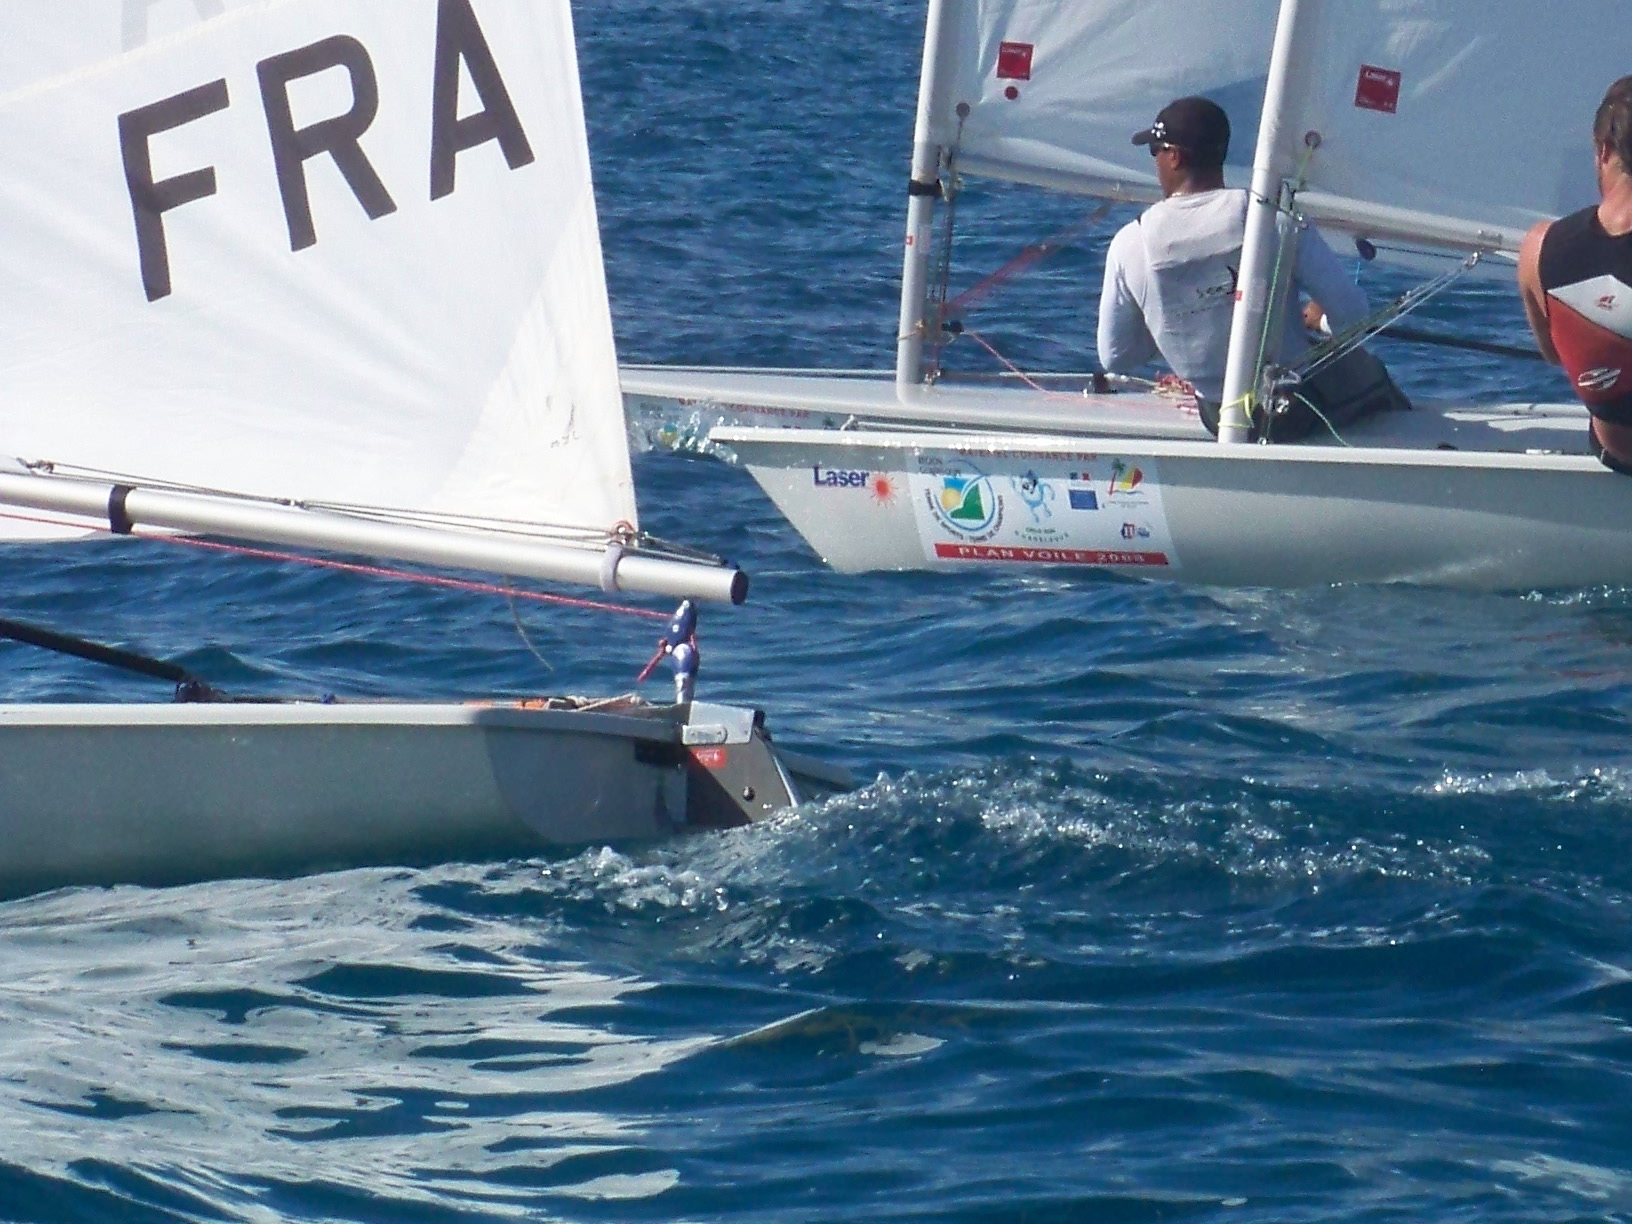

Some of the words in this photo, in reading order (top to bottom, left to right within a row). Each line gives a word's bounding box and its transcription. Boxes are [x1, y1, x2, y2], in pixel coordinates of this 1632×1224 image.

[814, 465, 870, 487] Laser
[958, 546, 1015, 559] PLAN
[1022, 550, 1086, 562] VOILE
